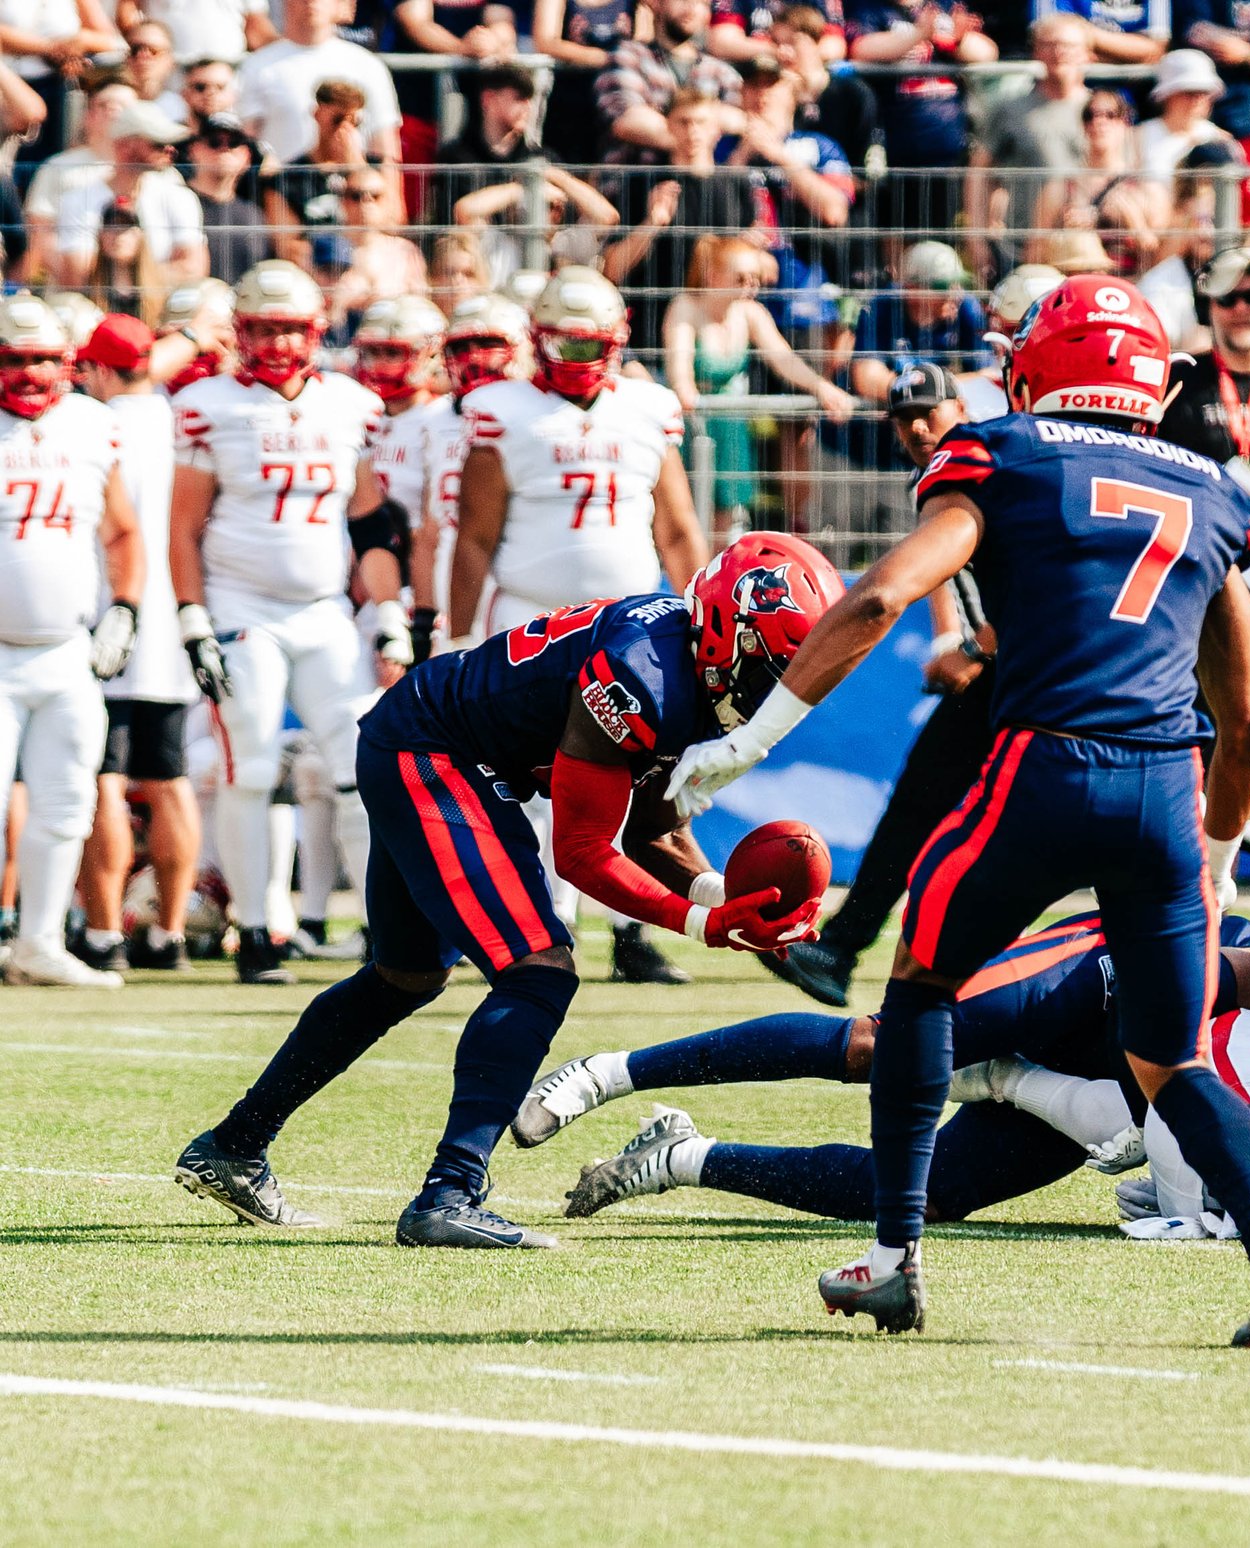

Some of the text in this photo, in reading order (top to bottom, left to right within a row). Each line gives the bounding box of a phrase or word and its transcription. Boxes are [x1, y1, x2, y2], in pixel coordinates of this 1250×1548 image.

[1106, 328, 1126, 359] 7
[1059, 392, 1152, 415] FORELLE
[1035, 420, 1222, 481] OMORODION
[6, 480, 73, 540] 74
[260, 463, 337, 524] 72
[561, 471, 617, 529] 71
[1089, 477, 1194, 625] 7
[591, 684, 629, 735] BLOCK
